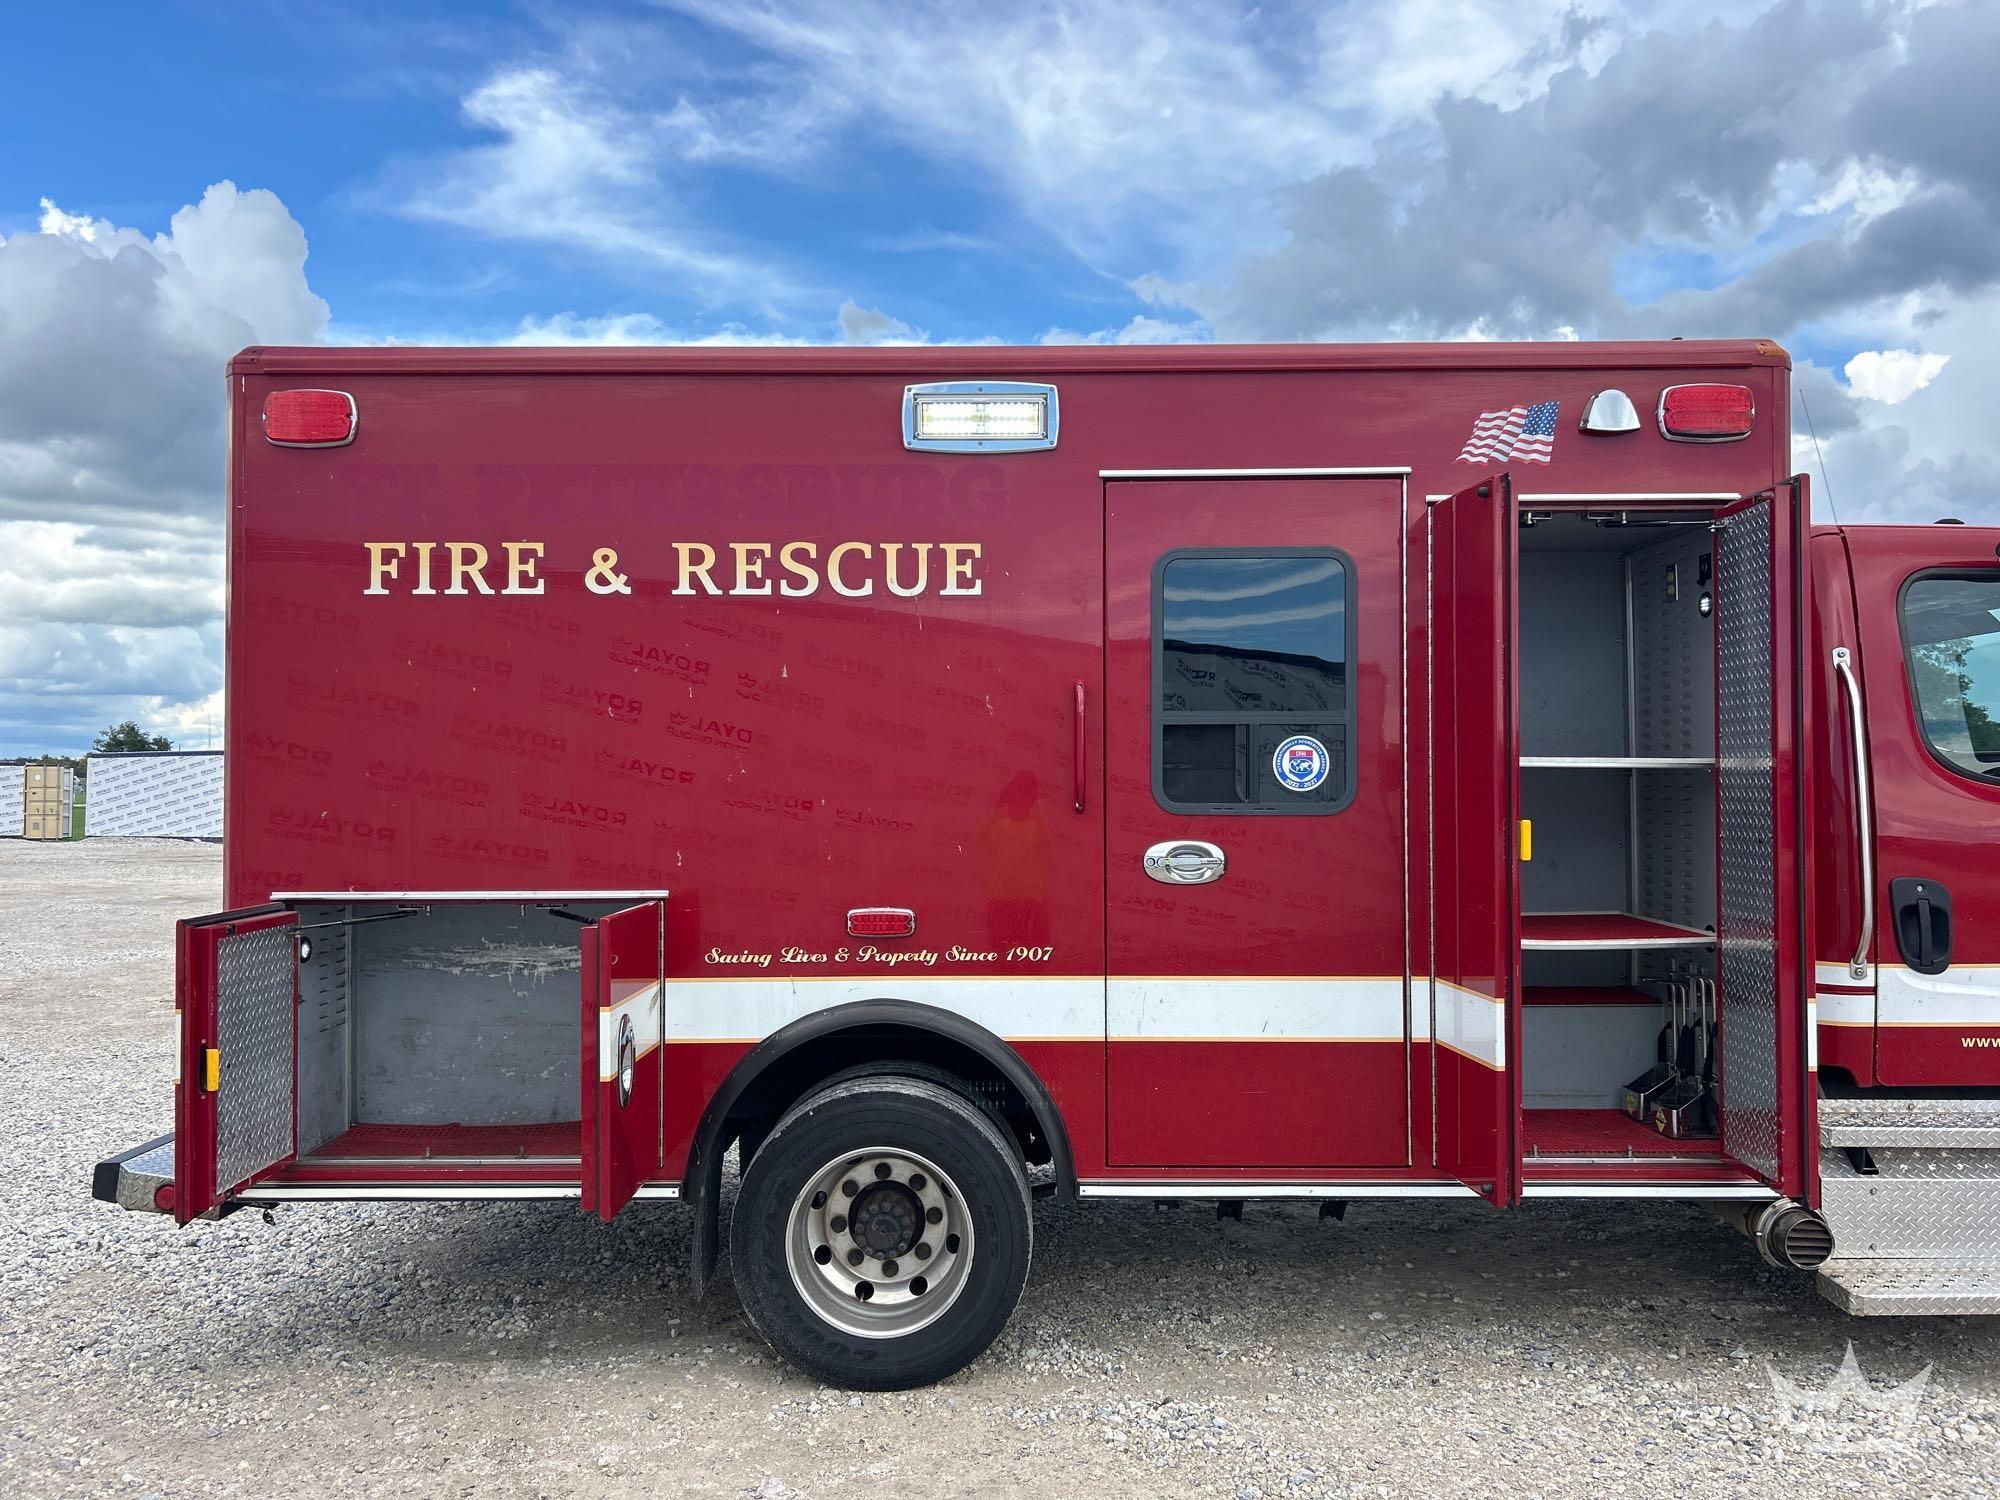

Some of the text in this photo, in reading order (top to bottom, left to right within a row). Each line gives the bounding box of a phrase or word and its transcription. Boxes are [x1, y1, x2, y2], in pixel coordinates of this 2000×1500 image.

[363, 541, 983, 597] FIRE & RESCUE
[704, 945, 1054, 968] Saving Lives & Property Since 1907
